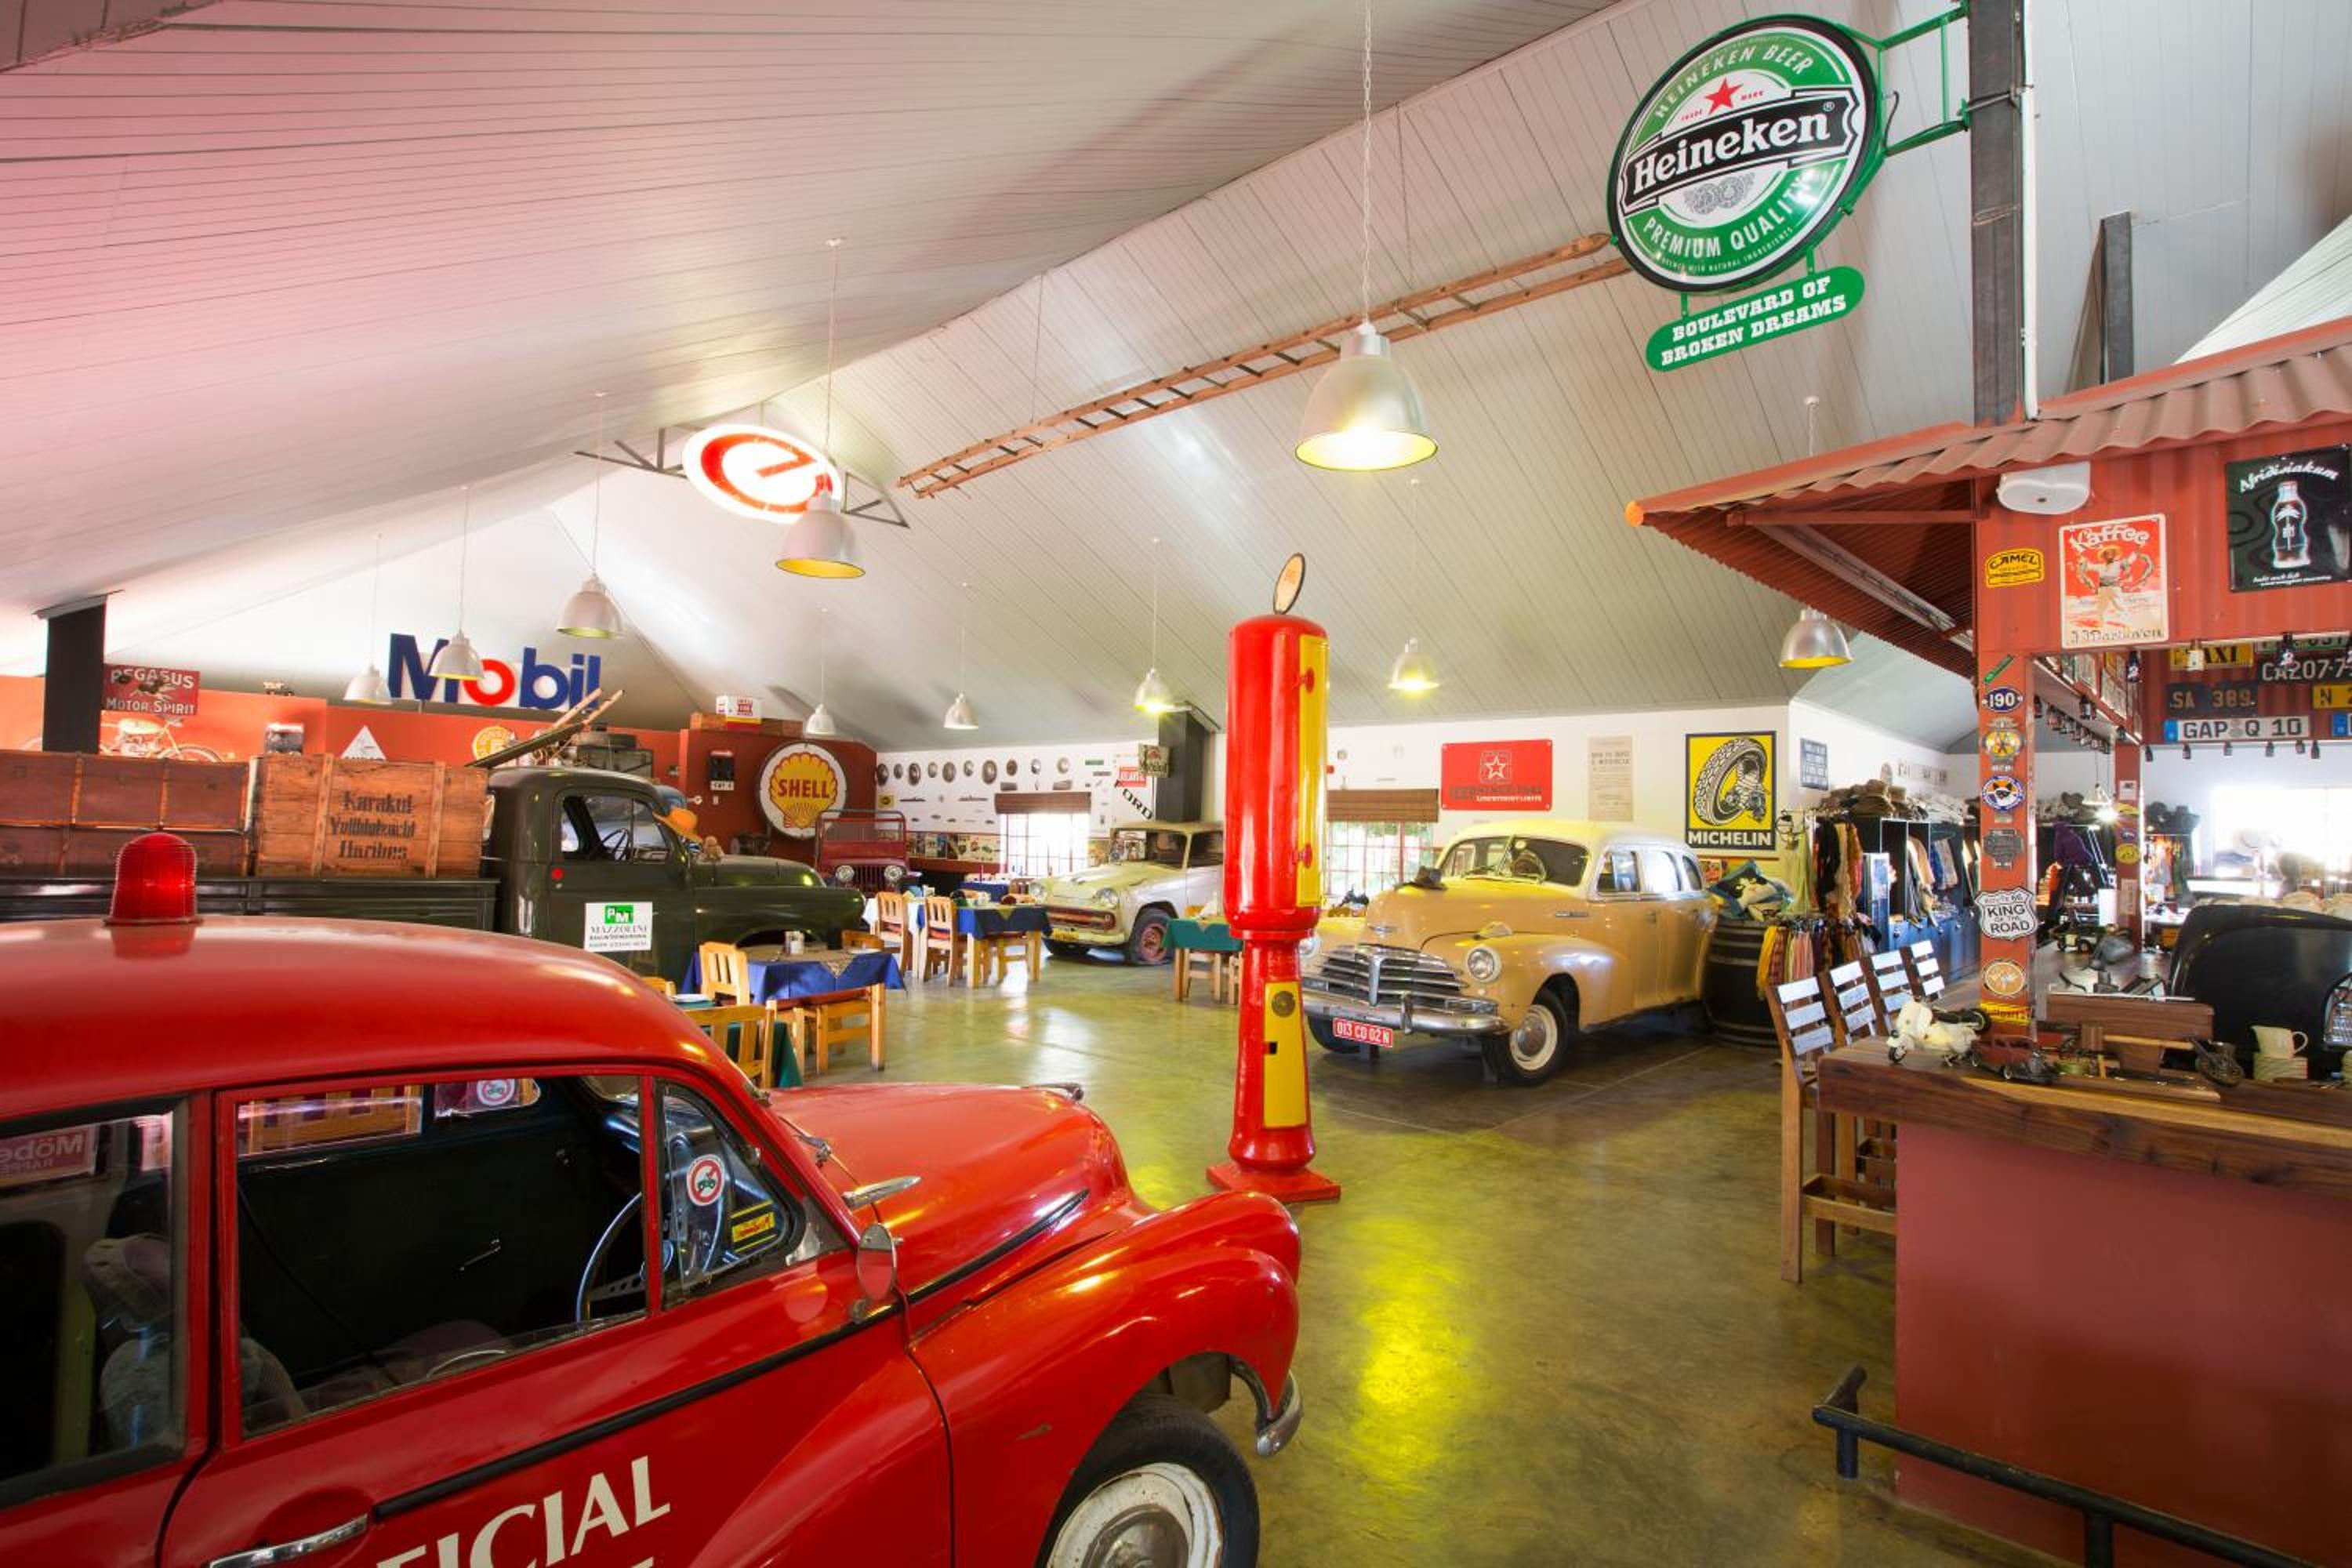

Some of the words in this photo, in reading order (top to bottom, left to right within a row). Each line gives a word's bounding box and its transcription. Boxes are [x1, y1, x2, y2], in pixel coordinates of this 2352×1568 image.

[1655, 45, 1755, 119] HEINEKEN
[1762, 44, 1813, 74] BEER
[1633, 112, 1831, 194] Heineken
[1643, 216, 1722, 259] PREMIUM
[1730, 177, 1812, 250] QUALITY
[1672, 288, 1795, 343] BOULEVARD
[1802, 276, 1831, 299] OF
[1661, 327, 1744, 366] BROKEN
[1751, 295, 1846, 339] DREAMS
[2069, 524, 2150, 552] Kaffee
[1989, 554, 2038, 569] CAMEL
[111, 667, 194, 689] PEGASUS
[388, 633, 601, 710] Mobil
[106, 697, 148, 711] MOTOR
[154, 700, 194, 715] SPIRIT
[1989, 692, 2015, 707] 190
[2172, 691, 2194, 709] SA
[2320, 688, 2332, 706] N
[2183, 720, 2228, 739] GAP
[2245, 720, 2260, 737] Q
[777, 779, 829, 799] SHELL
[1688, 830, 1771, 846] MICHELIN
[1987, 904, 2025, 917] KING
[1990, 920, 2031, 934] ROAD
[1337, 1022, 1352, 1036] 013
[1355, 1025, 1366, 1039] CD
